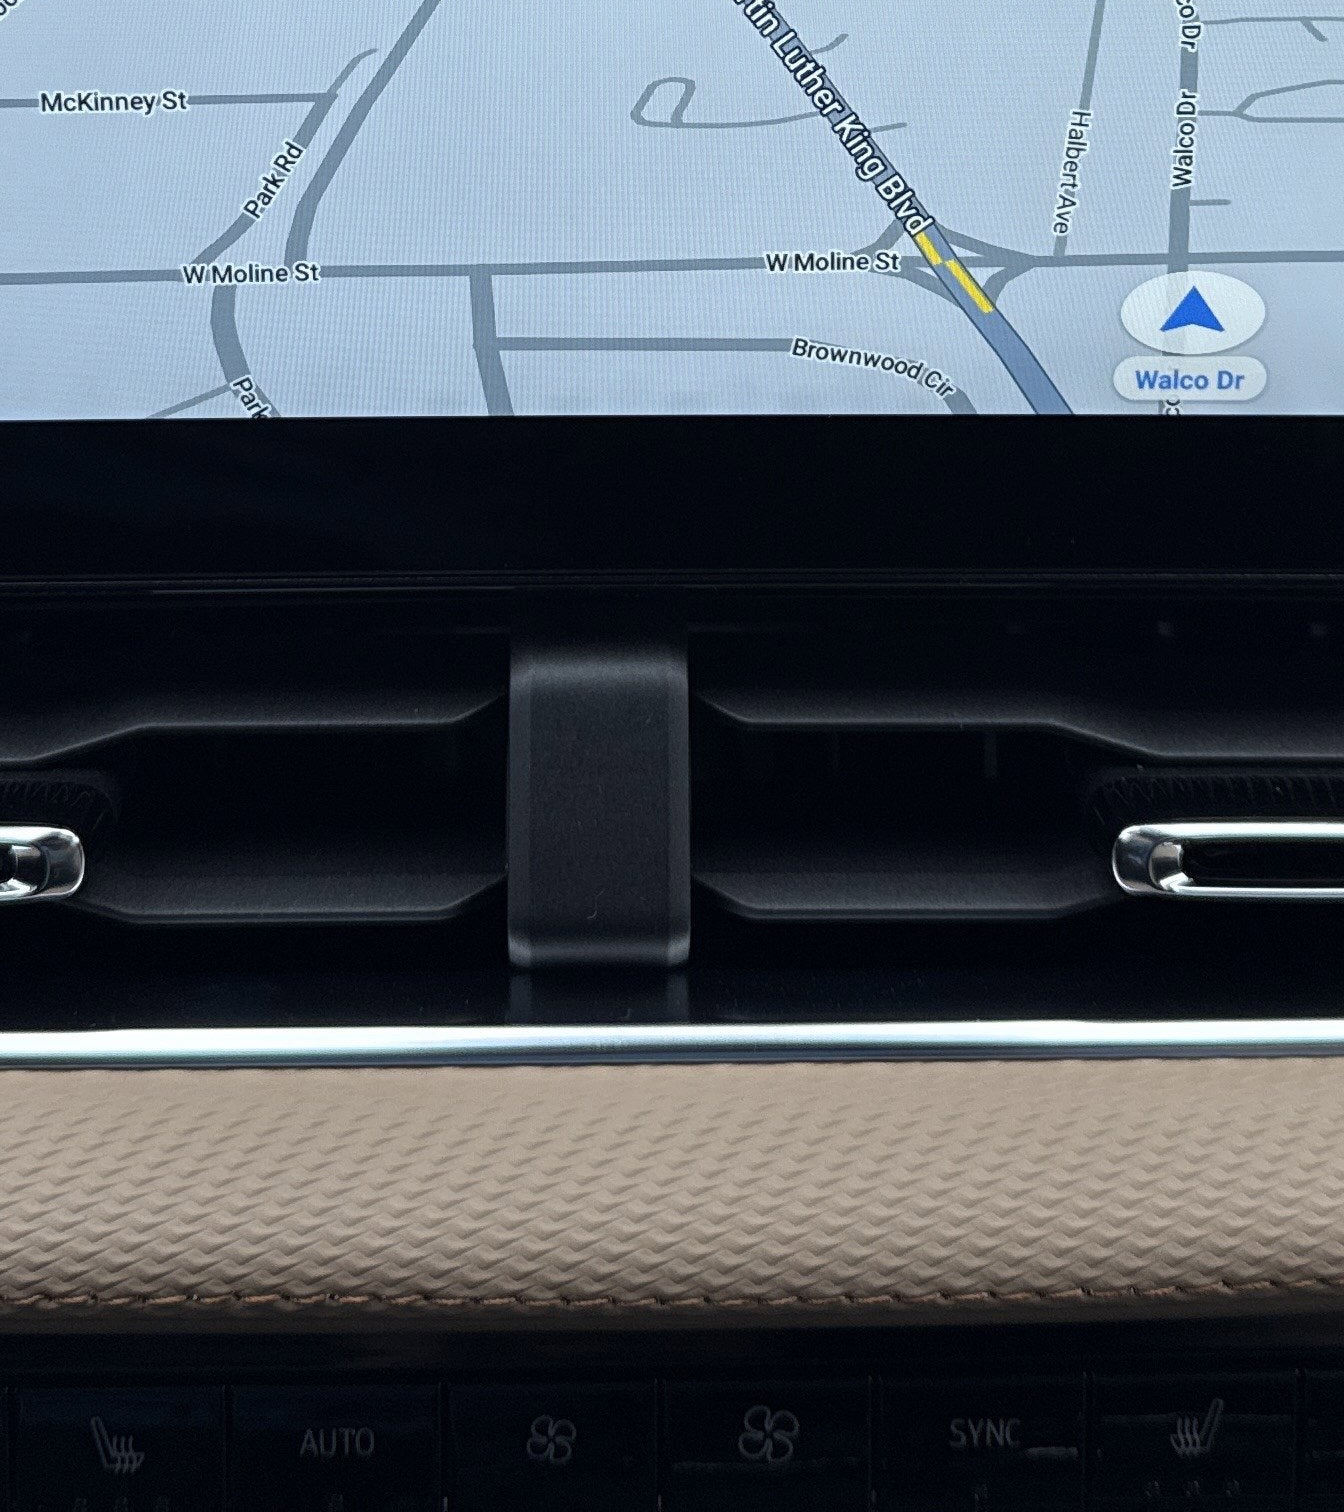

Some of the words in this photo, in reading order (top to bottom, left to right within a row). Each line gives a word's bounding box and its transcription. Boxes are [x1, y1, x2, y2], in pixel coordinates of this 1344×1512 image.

[1181, 23, 1202, 51] Dr
[41, 93, 156, 115] McKinney
[161, 91, 187, 110] St
[1177, 89, 1197, 115] Dr
[771, 29, 846, 117] Luther
[832, 113, 886, 182] King
[875, 174, 935, 237] Blvd
[1059, 109, 1091, 190] Halbert
[1172, 120, 1197, 188] Walco
[243, 172, 283, 220] Park
[273, 143, 304, 173] Rd
[1053, 193, 1078, 236] Ave
[183, 266, 206, 284] W
[212, 264, 289, 284] Moline
[294, 264, 320, 282] St
[766, 253, 789, 272] W
[794, 251, 870, 272] Moline
[875, 251, 901, 271] St
[791, 337, 924, 381] Brownwood
[923, 369, 956, 398] Cir
[1135, 370, 1210, 390] Walco
[1217, 370, 1245, 390] Dr
[299, 1427, 376, 1458] AUTO
[949, 1417, 1022, 1451] SYNC
